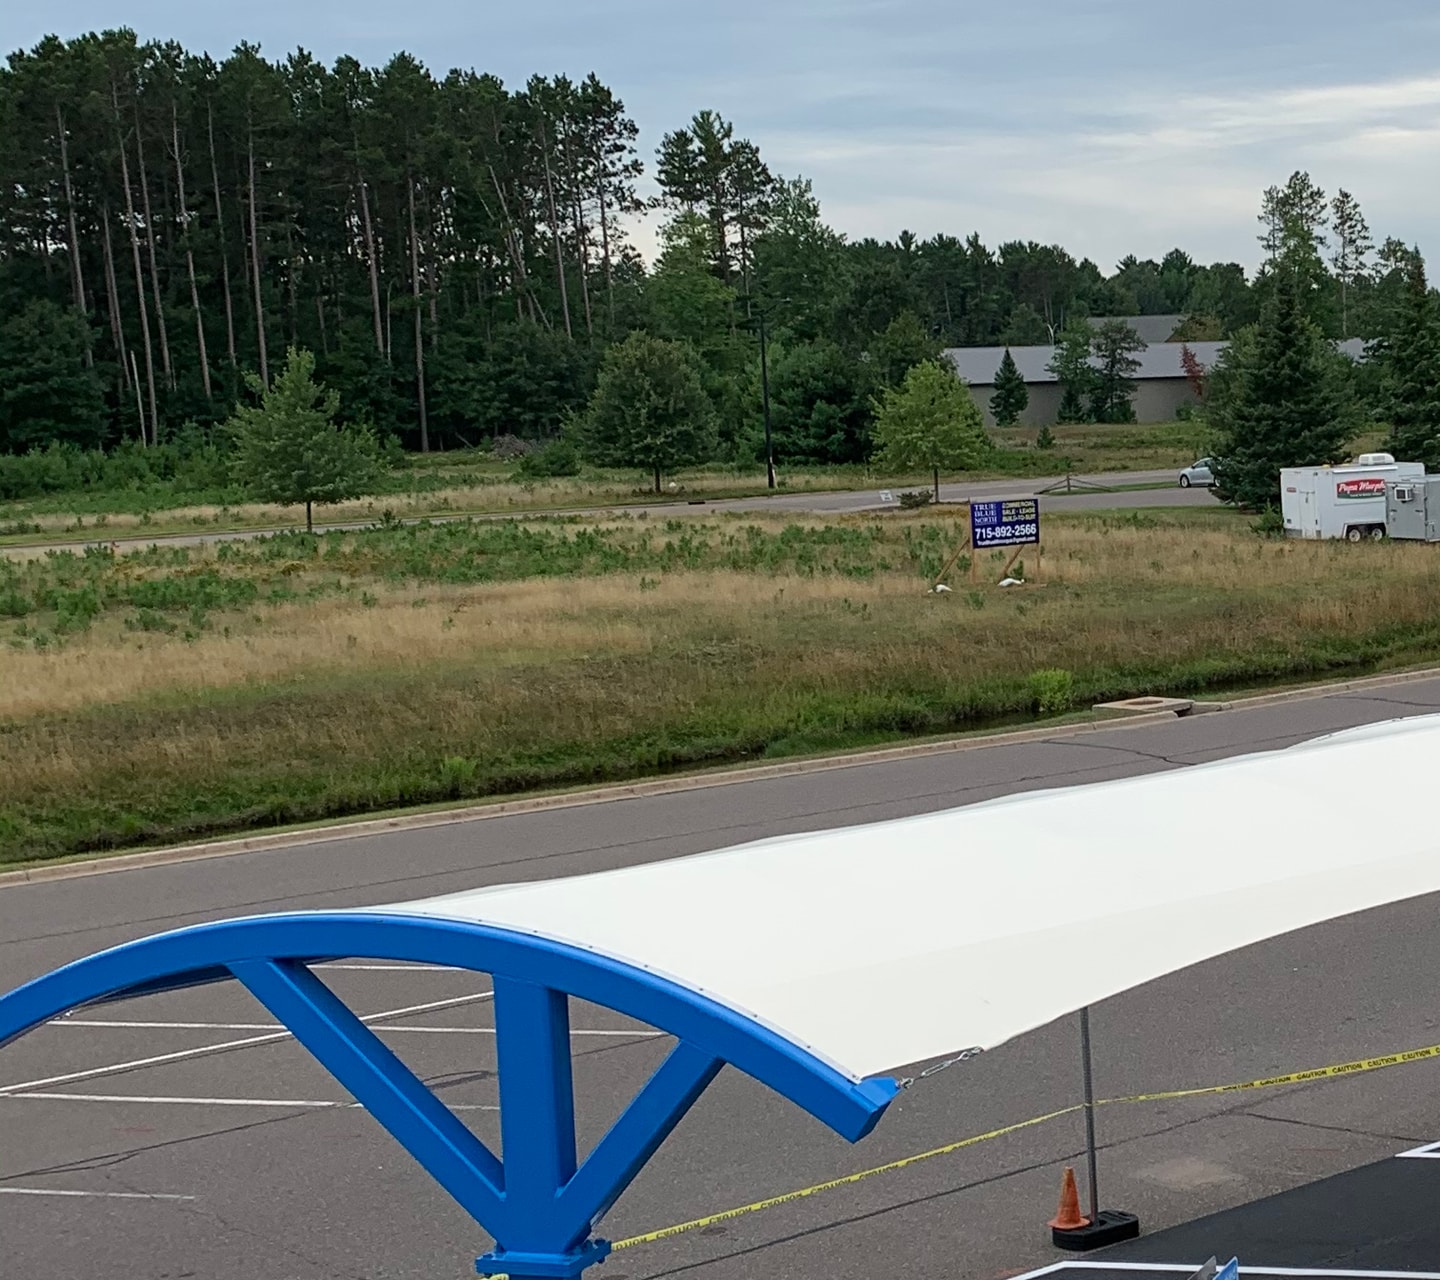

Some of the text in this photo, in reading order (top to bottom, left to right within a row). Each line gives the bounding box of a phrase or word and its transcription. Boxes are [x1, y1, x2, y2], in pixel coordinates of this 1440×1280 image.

[975, 523, 1037, 539] 715-892-2566
[1297, 1069, 1327, 1081] CAUTION
[1332, 1062, 1362, 1074] CAUTION
[1367, 1056, 1397, 1067] CAUTION
[1402, 1049, 1431, 1060] CAUTION
